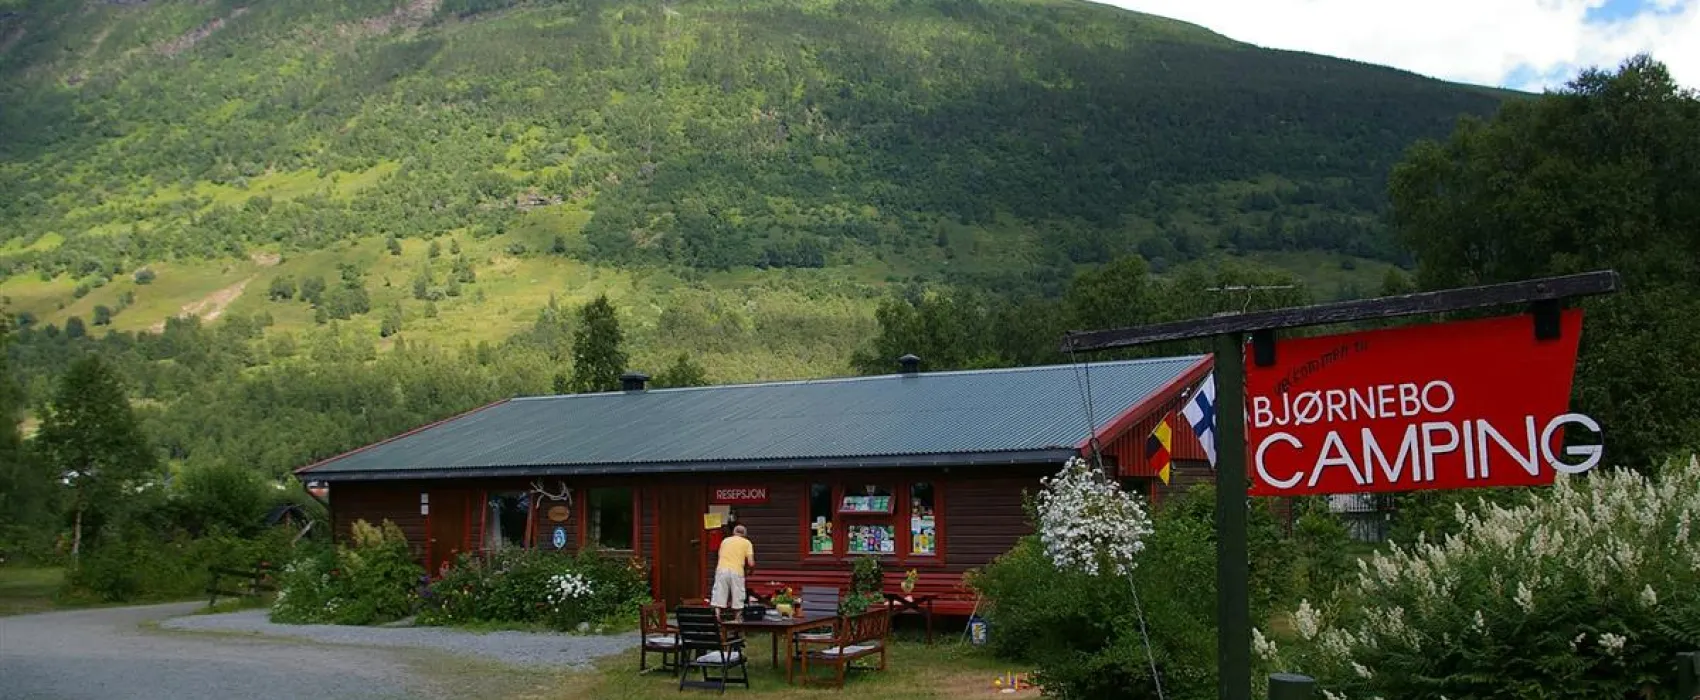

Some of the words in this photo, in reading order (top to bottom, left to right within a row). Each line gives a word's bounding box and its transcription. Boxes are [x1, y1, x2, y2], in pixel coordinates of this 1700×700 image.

[1254, 380, 1455, 428] BJØRNEBO
[1255, 413, 1603, 489] CAMPING
[716, 488, 766, 500] RESEPSJON
